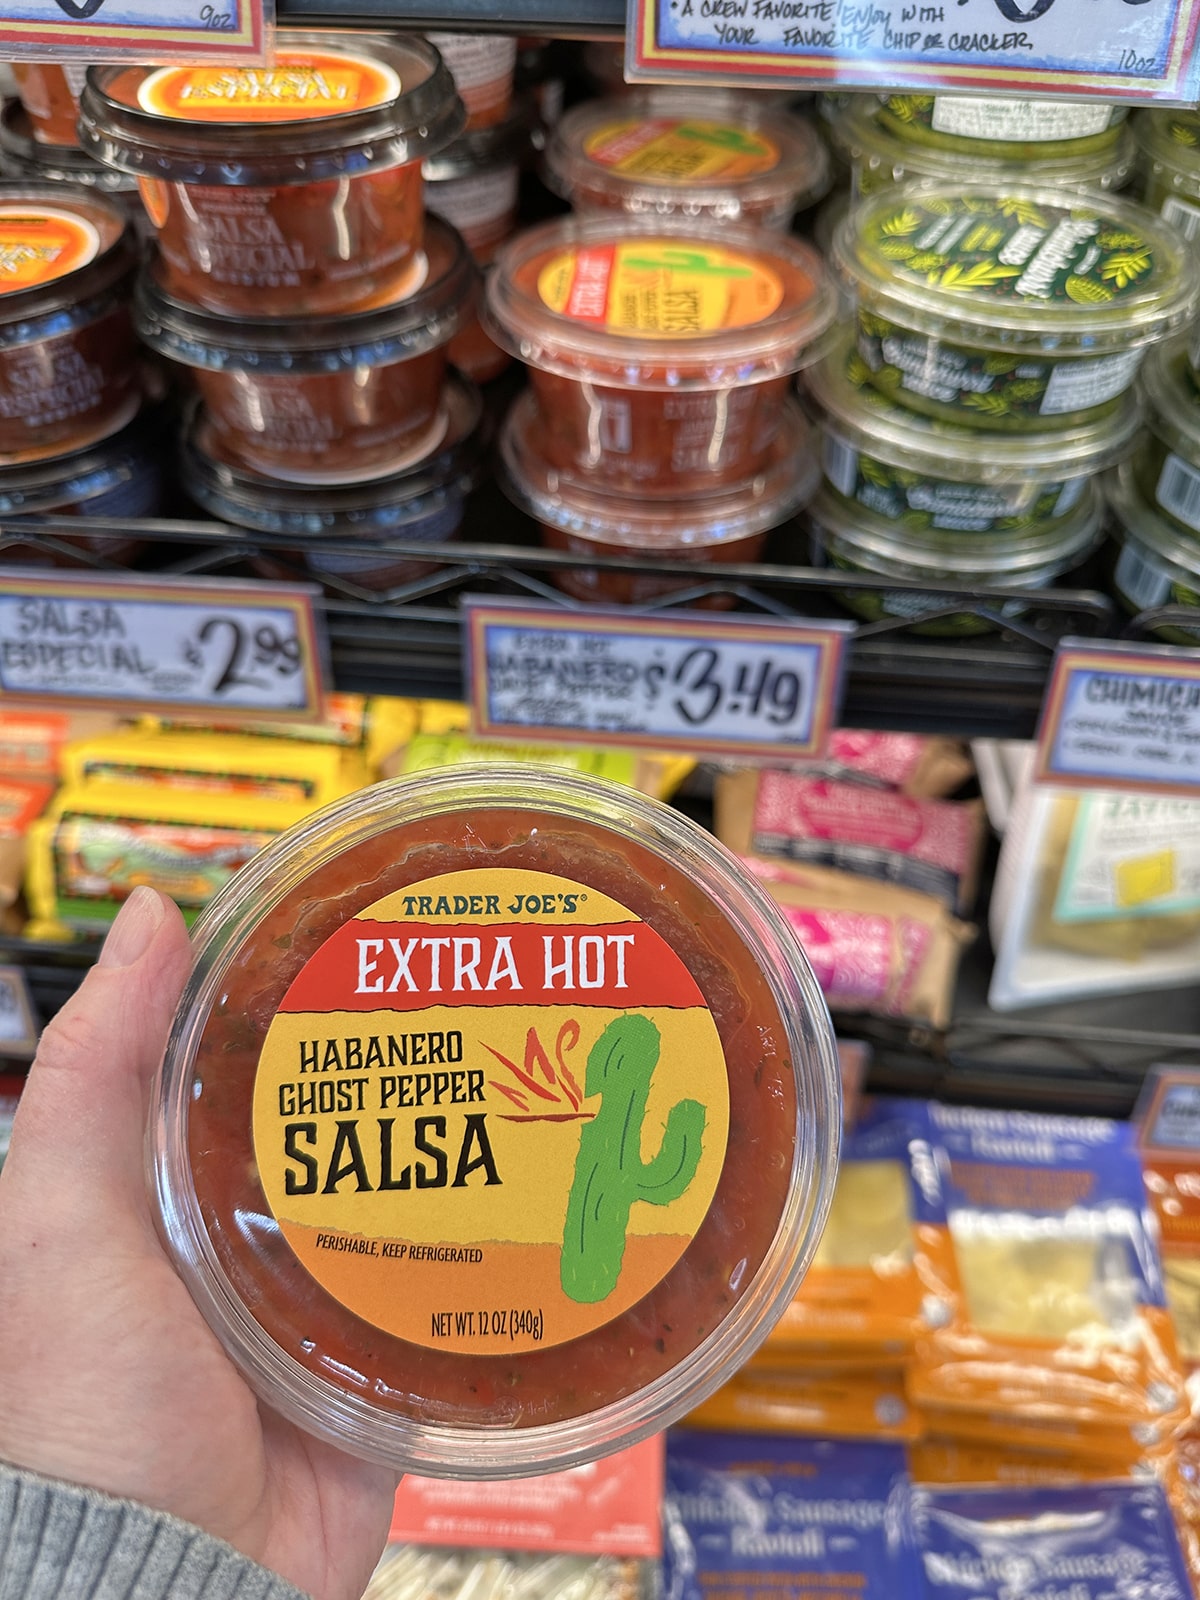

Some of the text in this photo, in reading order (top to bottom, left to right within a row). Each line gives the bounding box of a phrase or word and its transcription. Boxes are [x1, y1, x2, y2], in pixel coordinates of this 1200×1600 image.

[681, 0, 694, 17] A
[701, 0, 748, 18] CREW
[901, 4, 945, 23] WITH
[714, 23, 760, 46] YOUR
[783, 26, 875, 50] FAVORITE
[882, 29, 921, 49] CHIP
[17, 602, 126, 637] SALSA
[3, 640, 157, 673] ESPECIAL
[645, 646, 802, 728] $3.49
[402, 895, 501, 915] TRADER
[354, 934, 635, 994] EXTRA HOT
[299, 1030, 463, 1073] HABANERO
[279, 1069, 487, 1117] GHOST PEPPER
[284, 1112, 503, 1196] SALSA
[316, 1233, 483, 1262] PERISHABLE, KEEP REFRIGERATED
[431, 1308, 543, 1341] NET WT. 12 OZ (340g)
